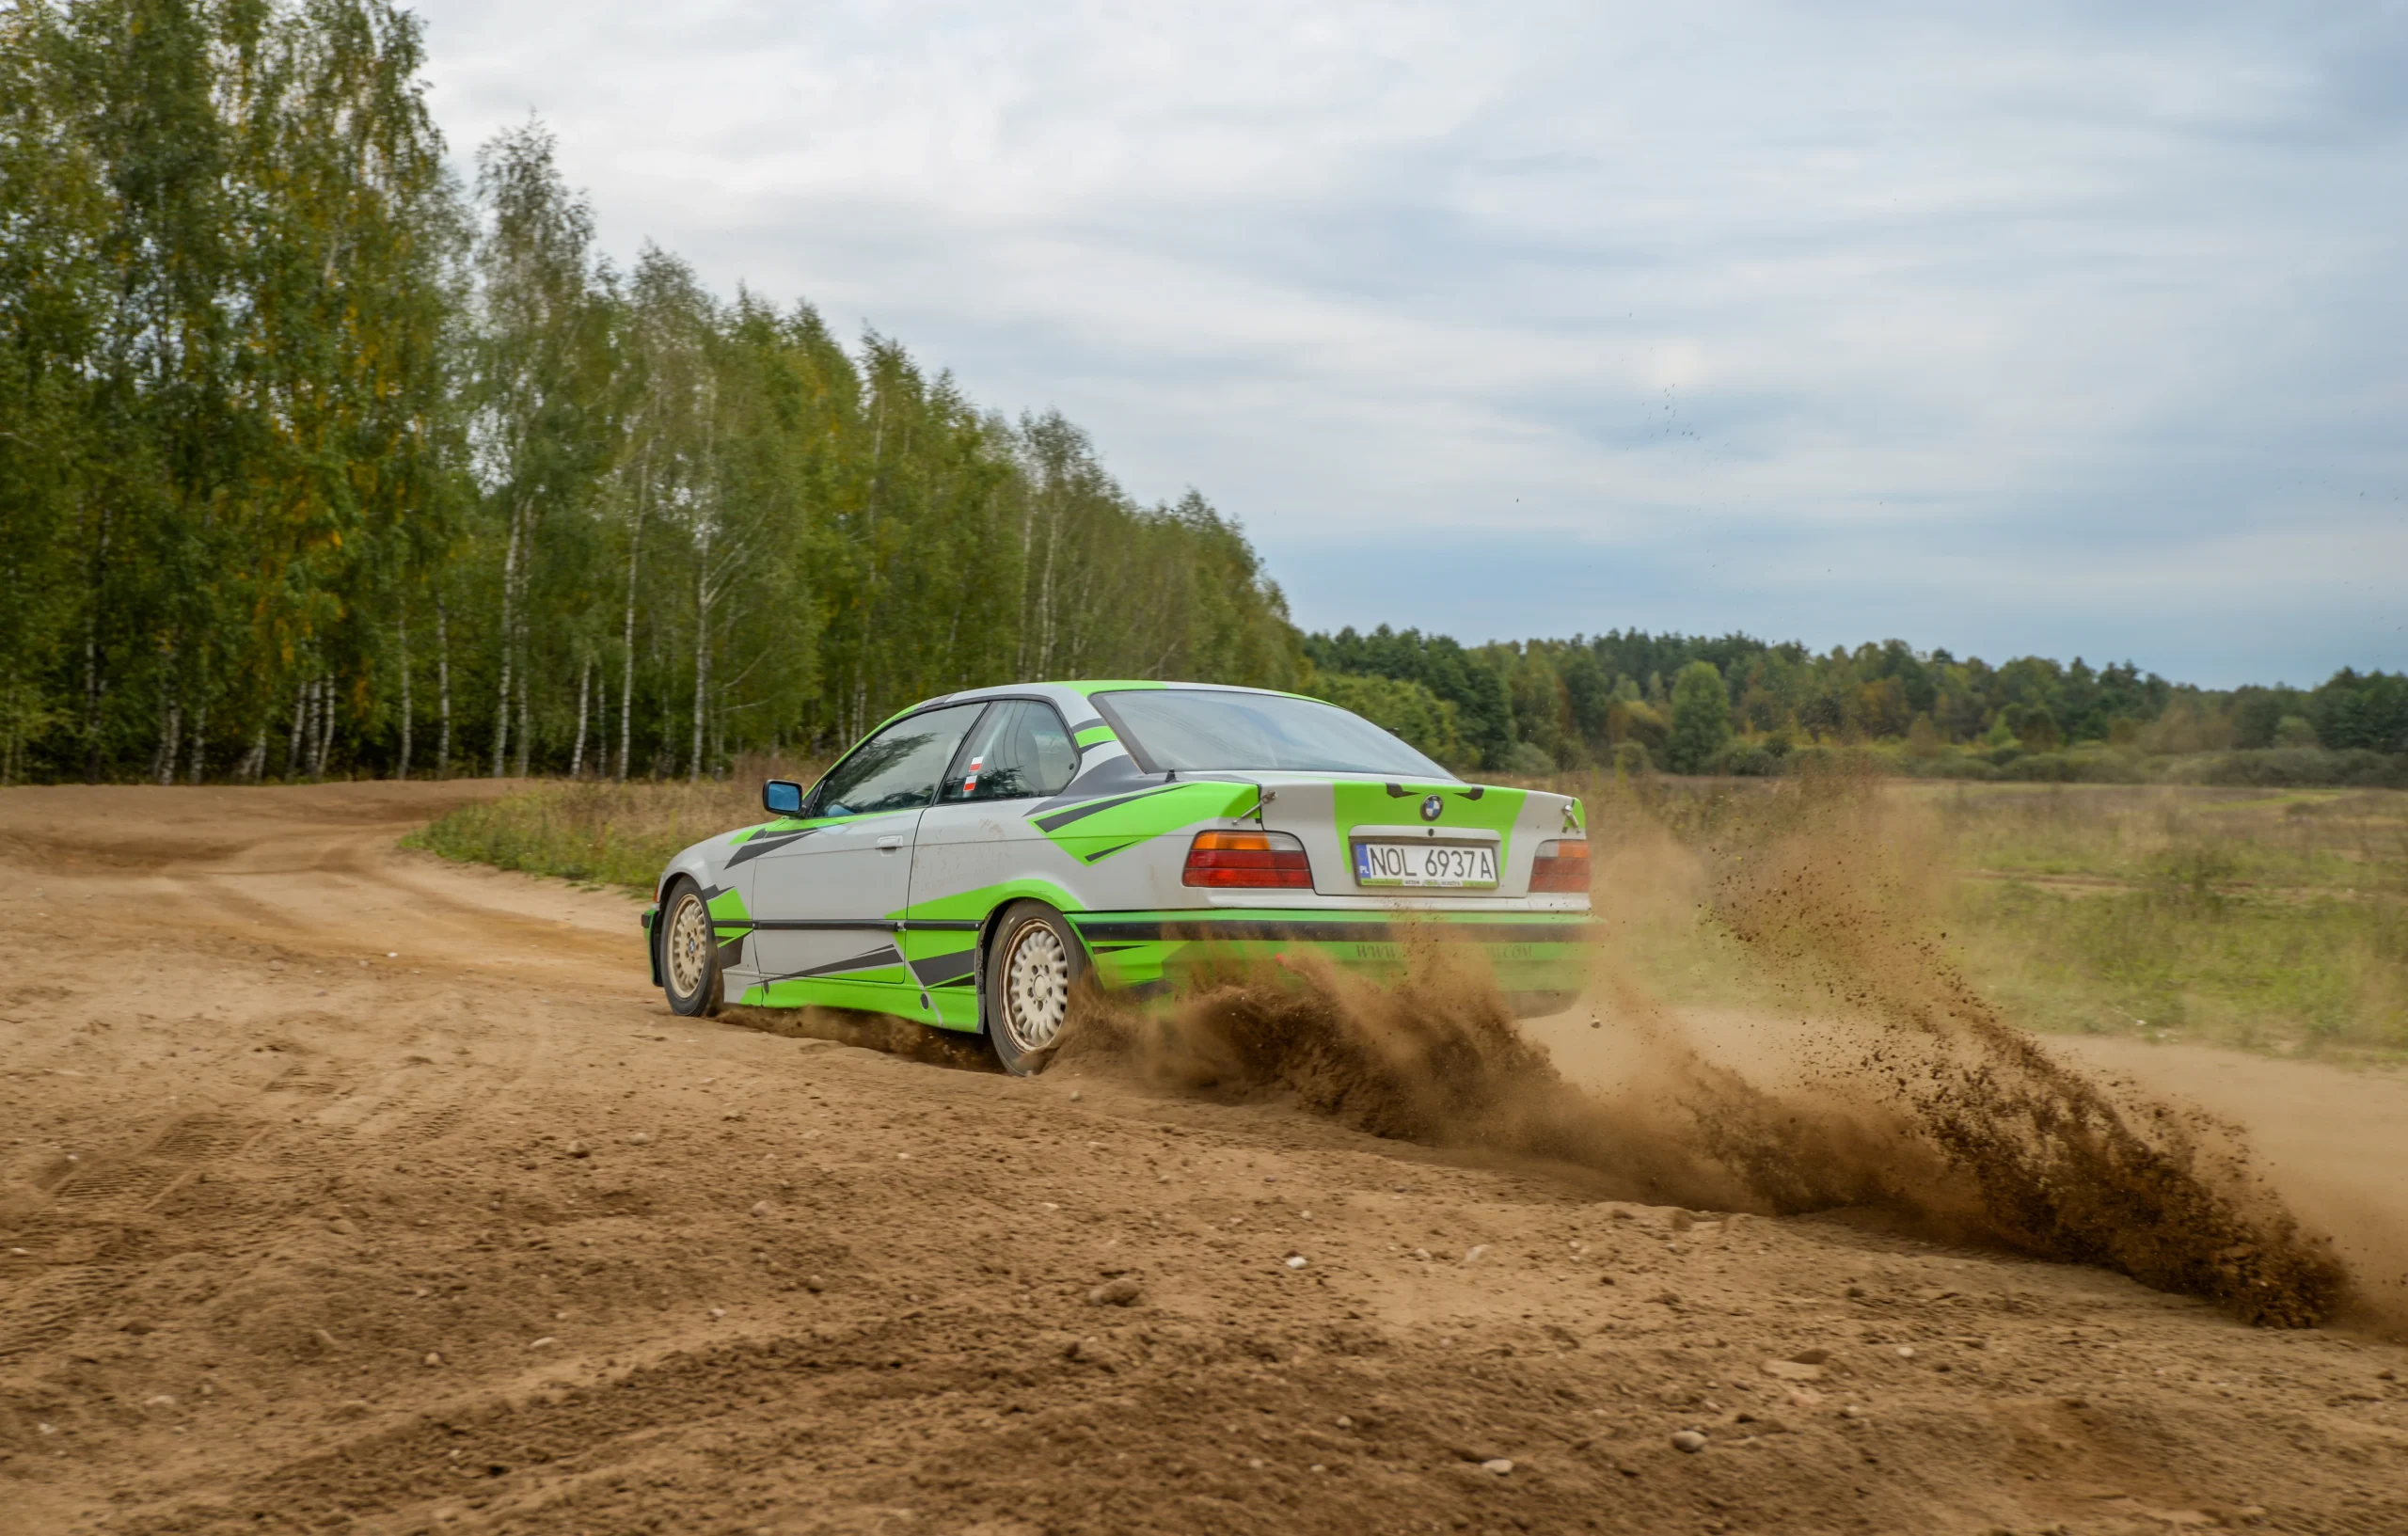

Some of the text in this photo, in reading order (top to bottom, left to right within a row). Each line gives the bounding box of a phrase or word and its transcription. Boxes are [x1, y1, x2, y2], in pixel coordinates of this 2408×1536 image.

[1359, 865, 1370, 874] PL
[1370, 847, 1493, 879] NOL 6937A
